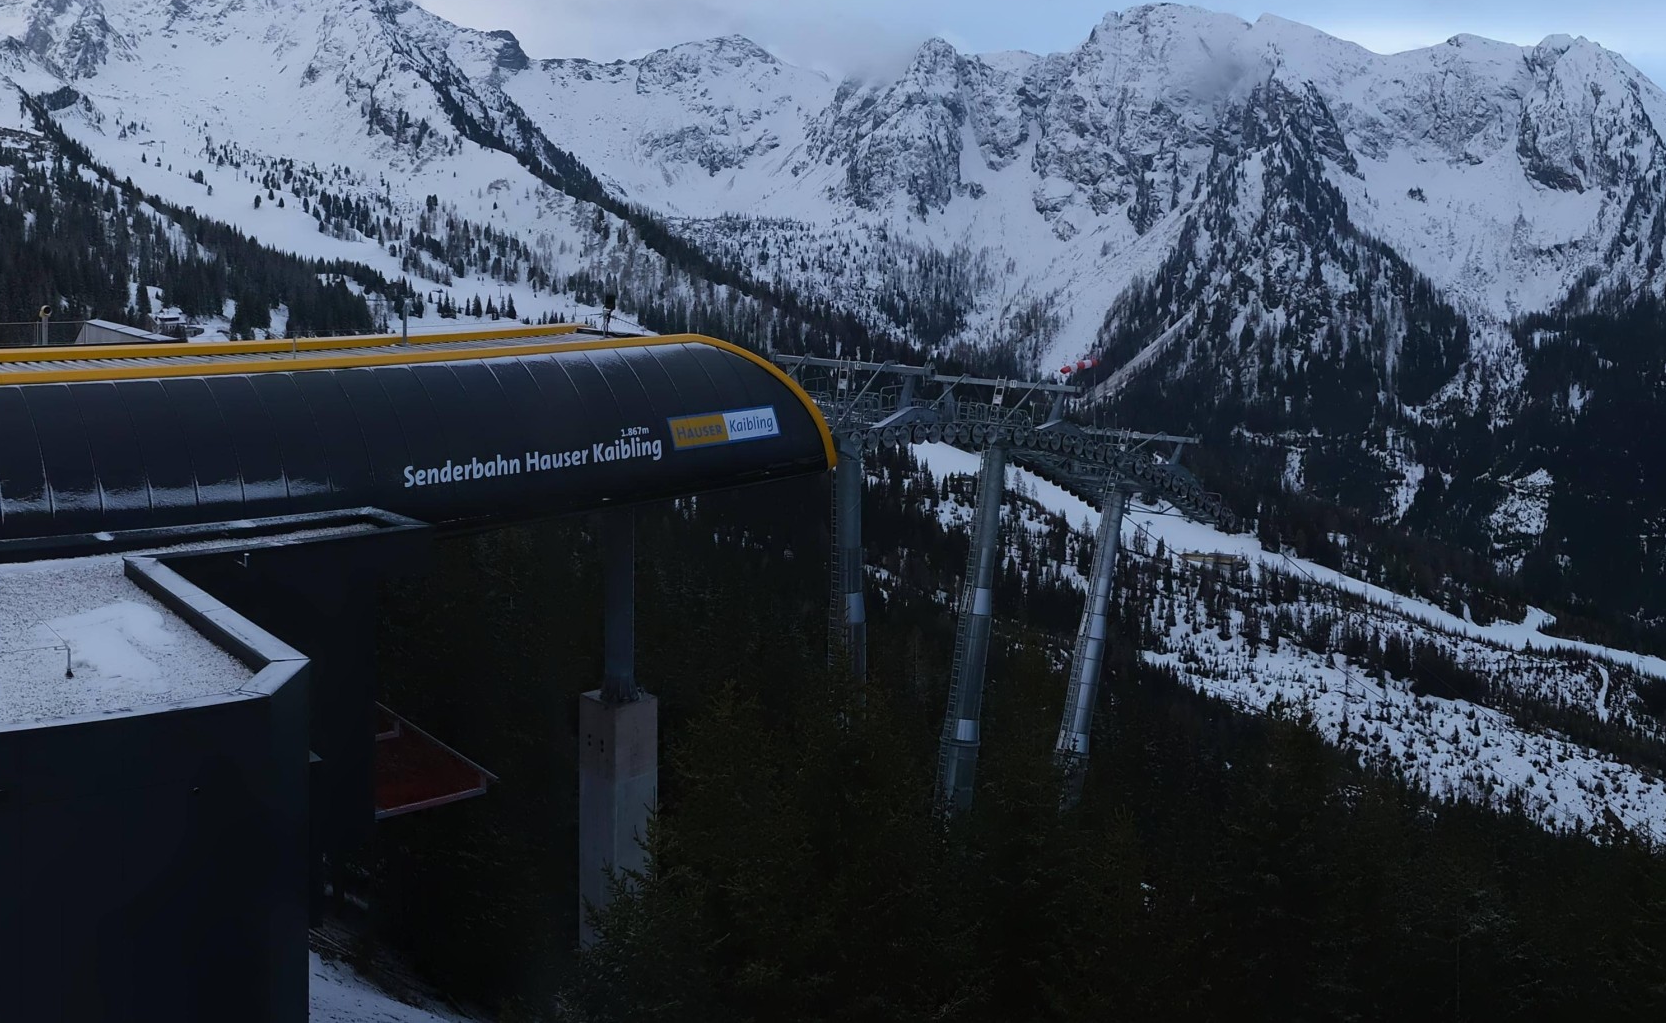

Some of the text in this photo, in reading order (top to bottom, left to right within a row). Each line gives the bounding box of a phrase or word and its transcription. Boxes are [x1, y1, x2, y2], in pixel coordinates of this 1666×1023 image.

[620, 426, 649, 437] 1.867m
[677, 415, 774, 440] HAUSER Kaibling
[403, 436, 662, 488] Senderbahn Hauser Kaibling
